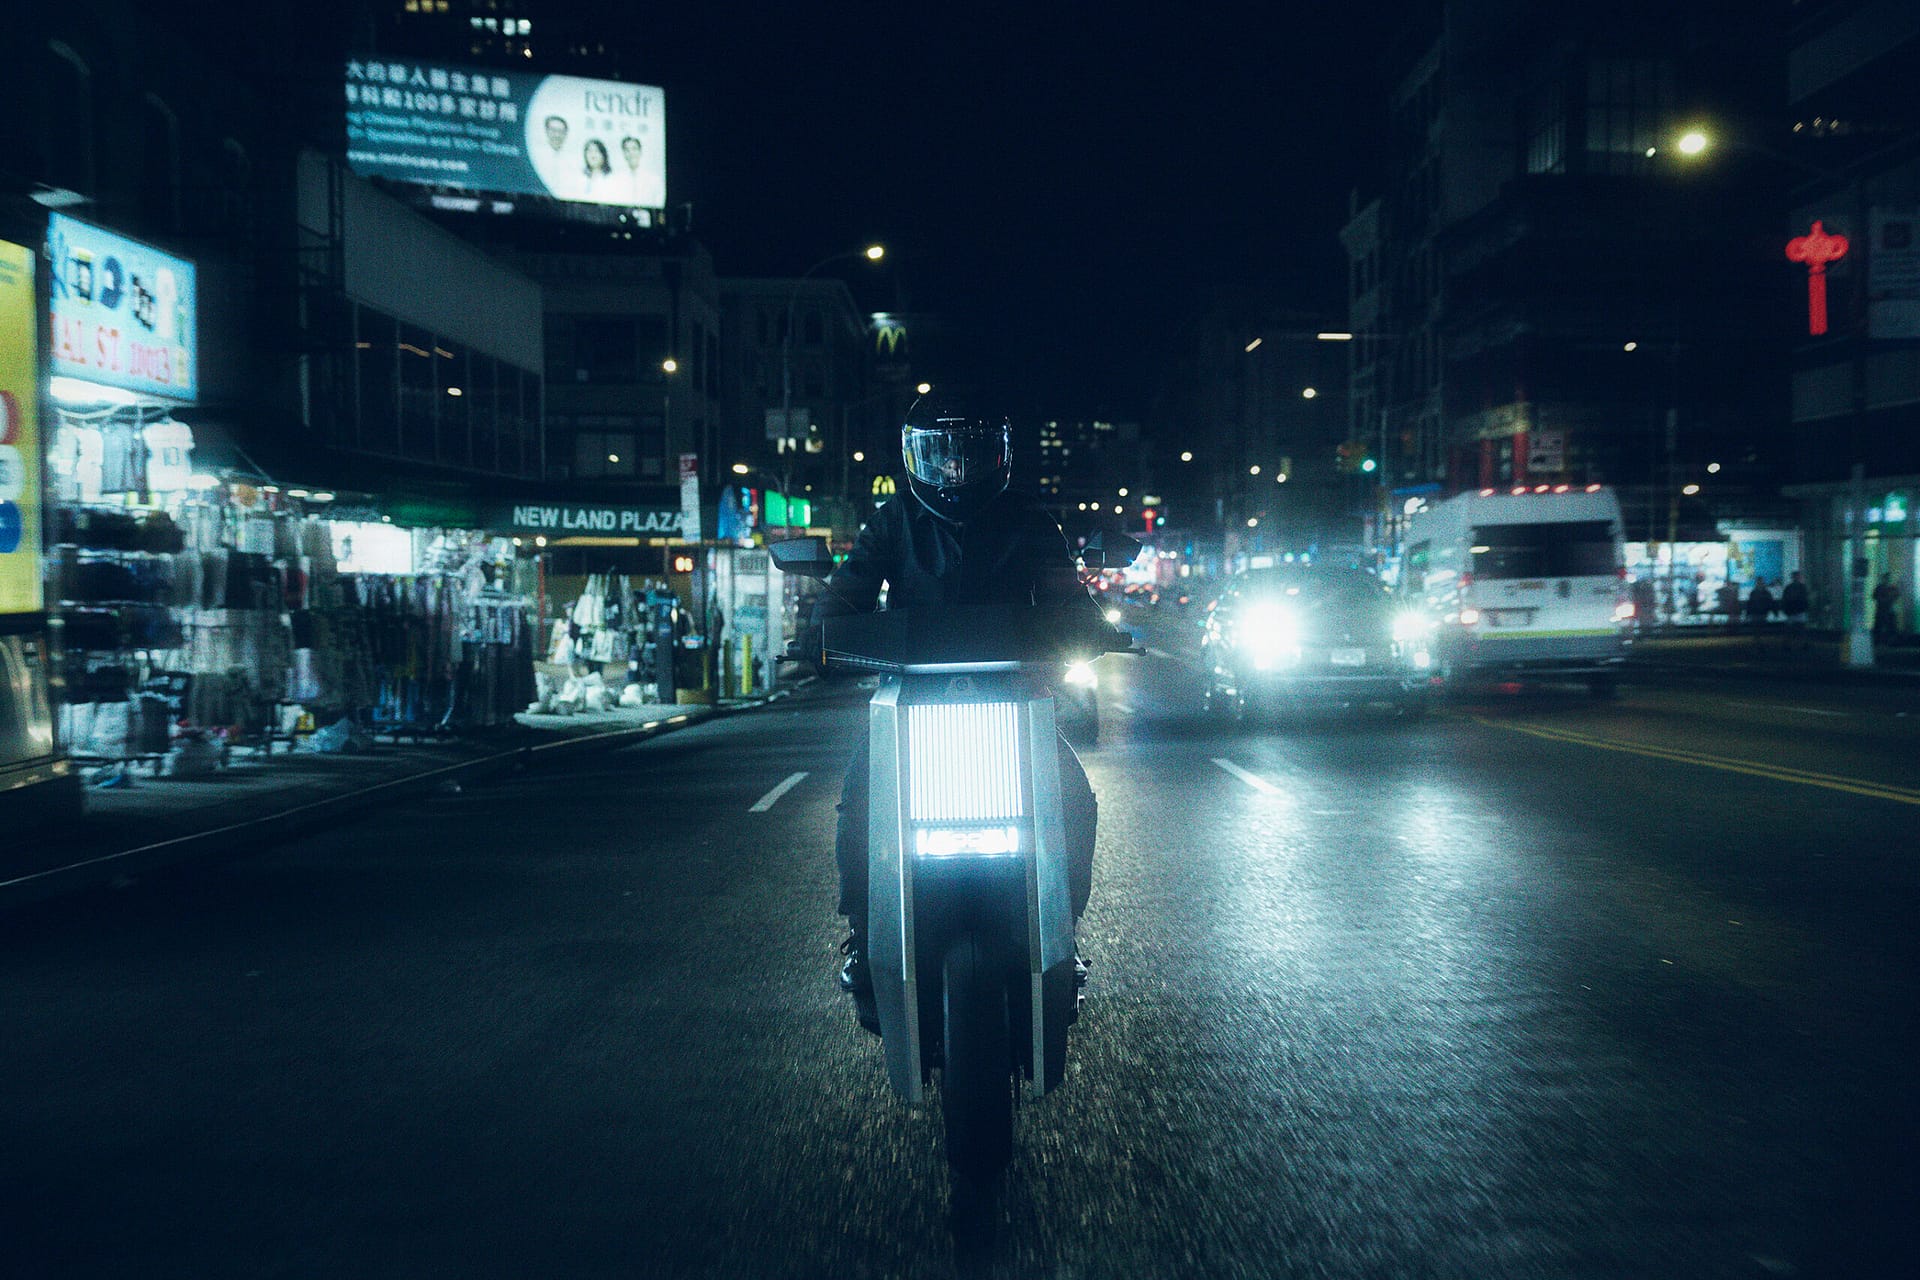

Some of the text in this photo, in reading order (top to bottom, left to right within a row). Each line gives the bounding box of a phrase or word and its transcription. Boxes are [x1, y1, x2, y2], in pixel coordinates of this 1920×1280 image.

[584, 90, 652, 118] rendr
[513, 505, 684, 532] NEW LAND PLAZA
